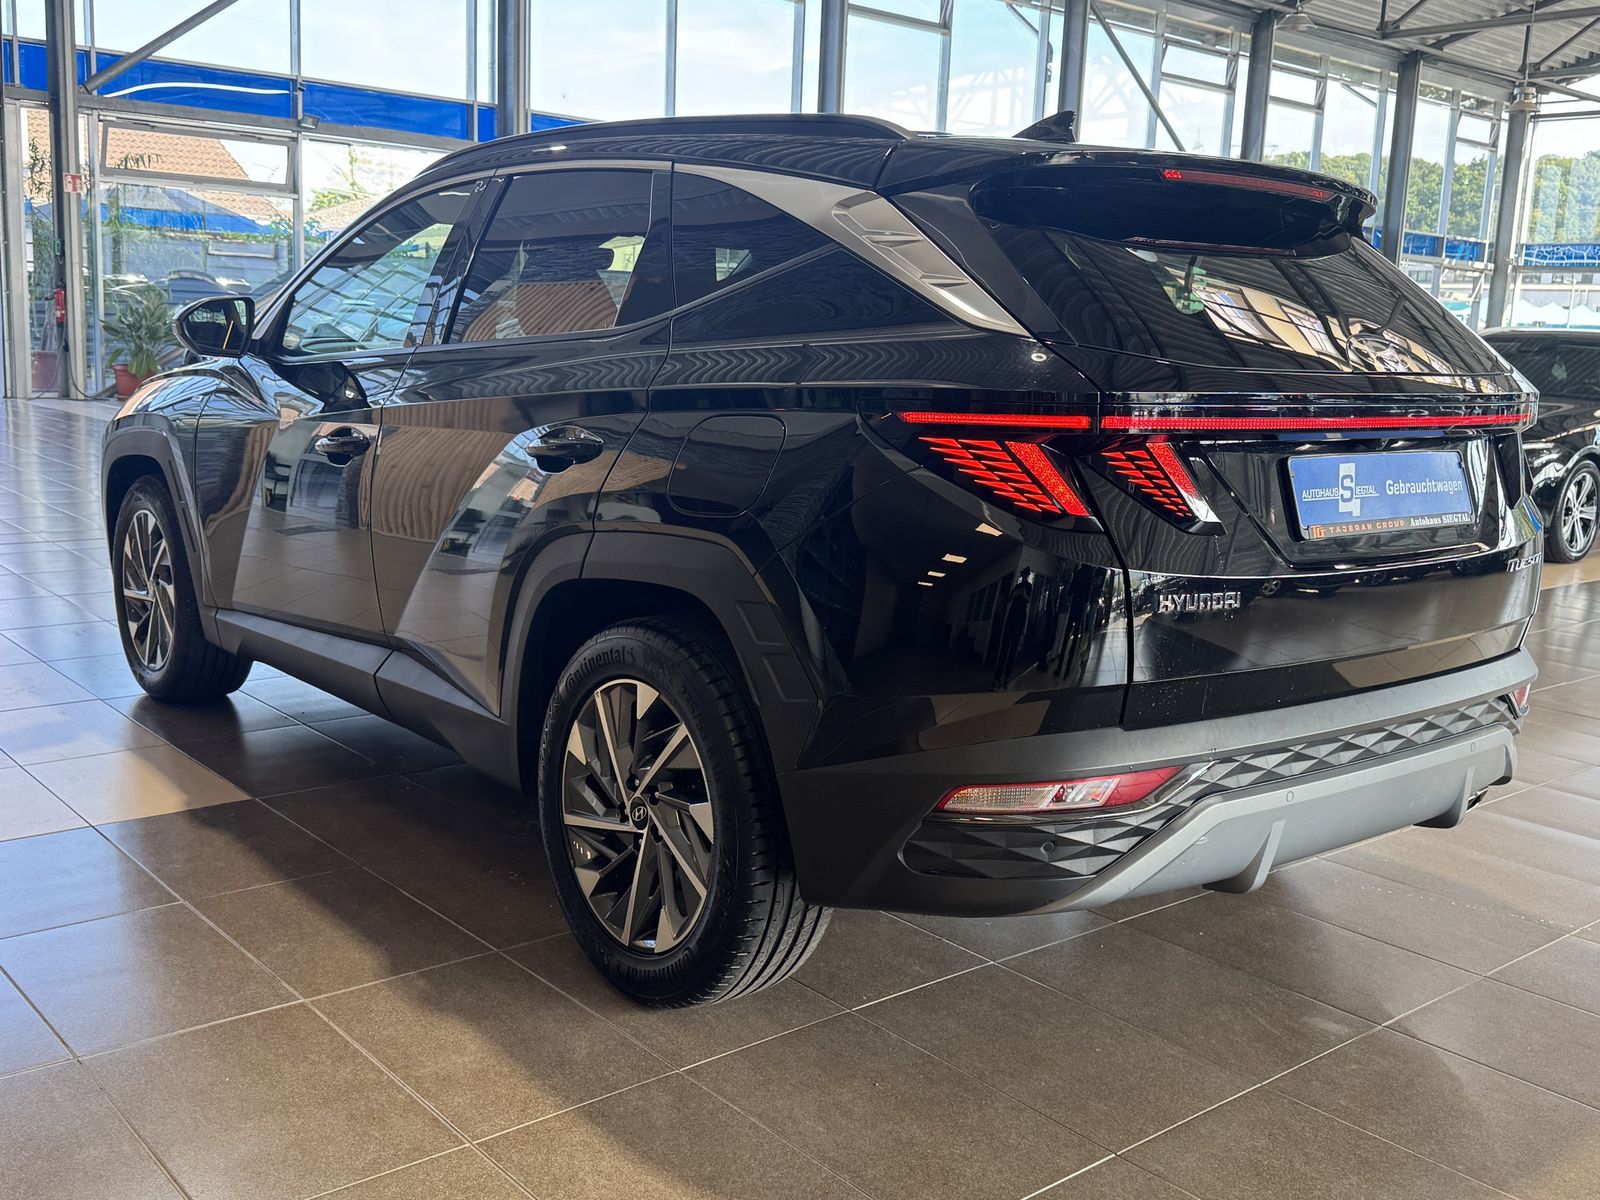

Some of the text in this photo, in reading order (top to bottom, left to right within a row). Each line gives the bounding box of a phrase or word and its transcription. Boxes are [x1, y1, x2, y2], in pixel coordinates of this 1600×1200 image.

[1302, 488, 1339, 500] AUTOHAUS
[1385, 478, 1463, 495] Gebrauchtwagen
[1376, 519, 1405, 529] GROUP
[1410, 516, 1442, 527] Autohaus
[1442, 513, 1470, 524] SIEGTAL
[1158, 591, 1241, 612] HYUNDAI
[565, 645, 626, 691] Continental
